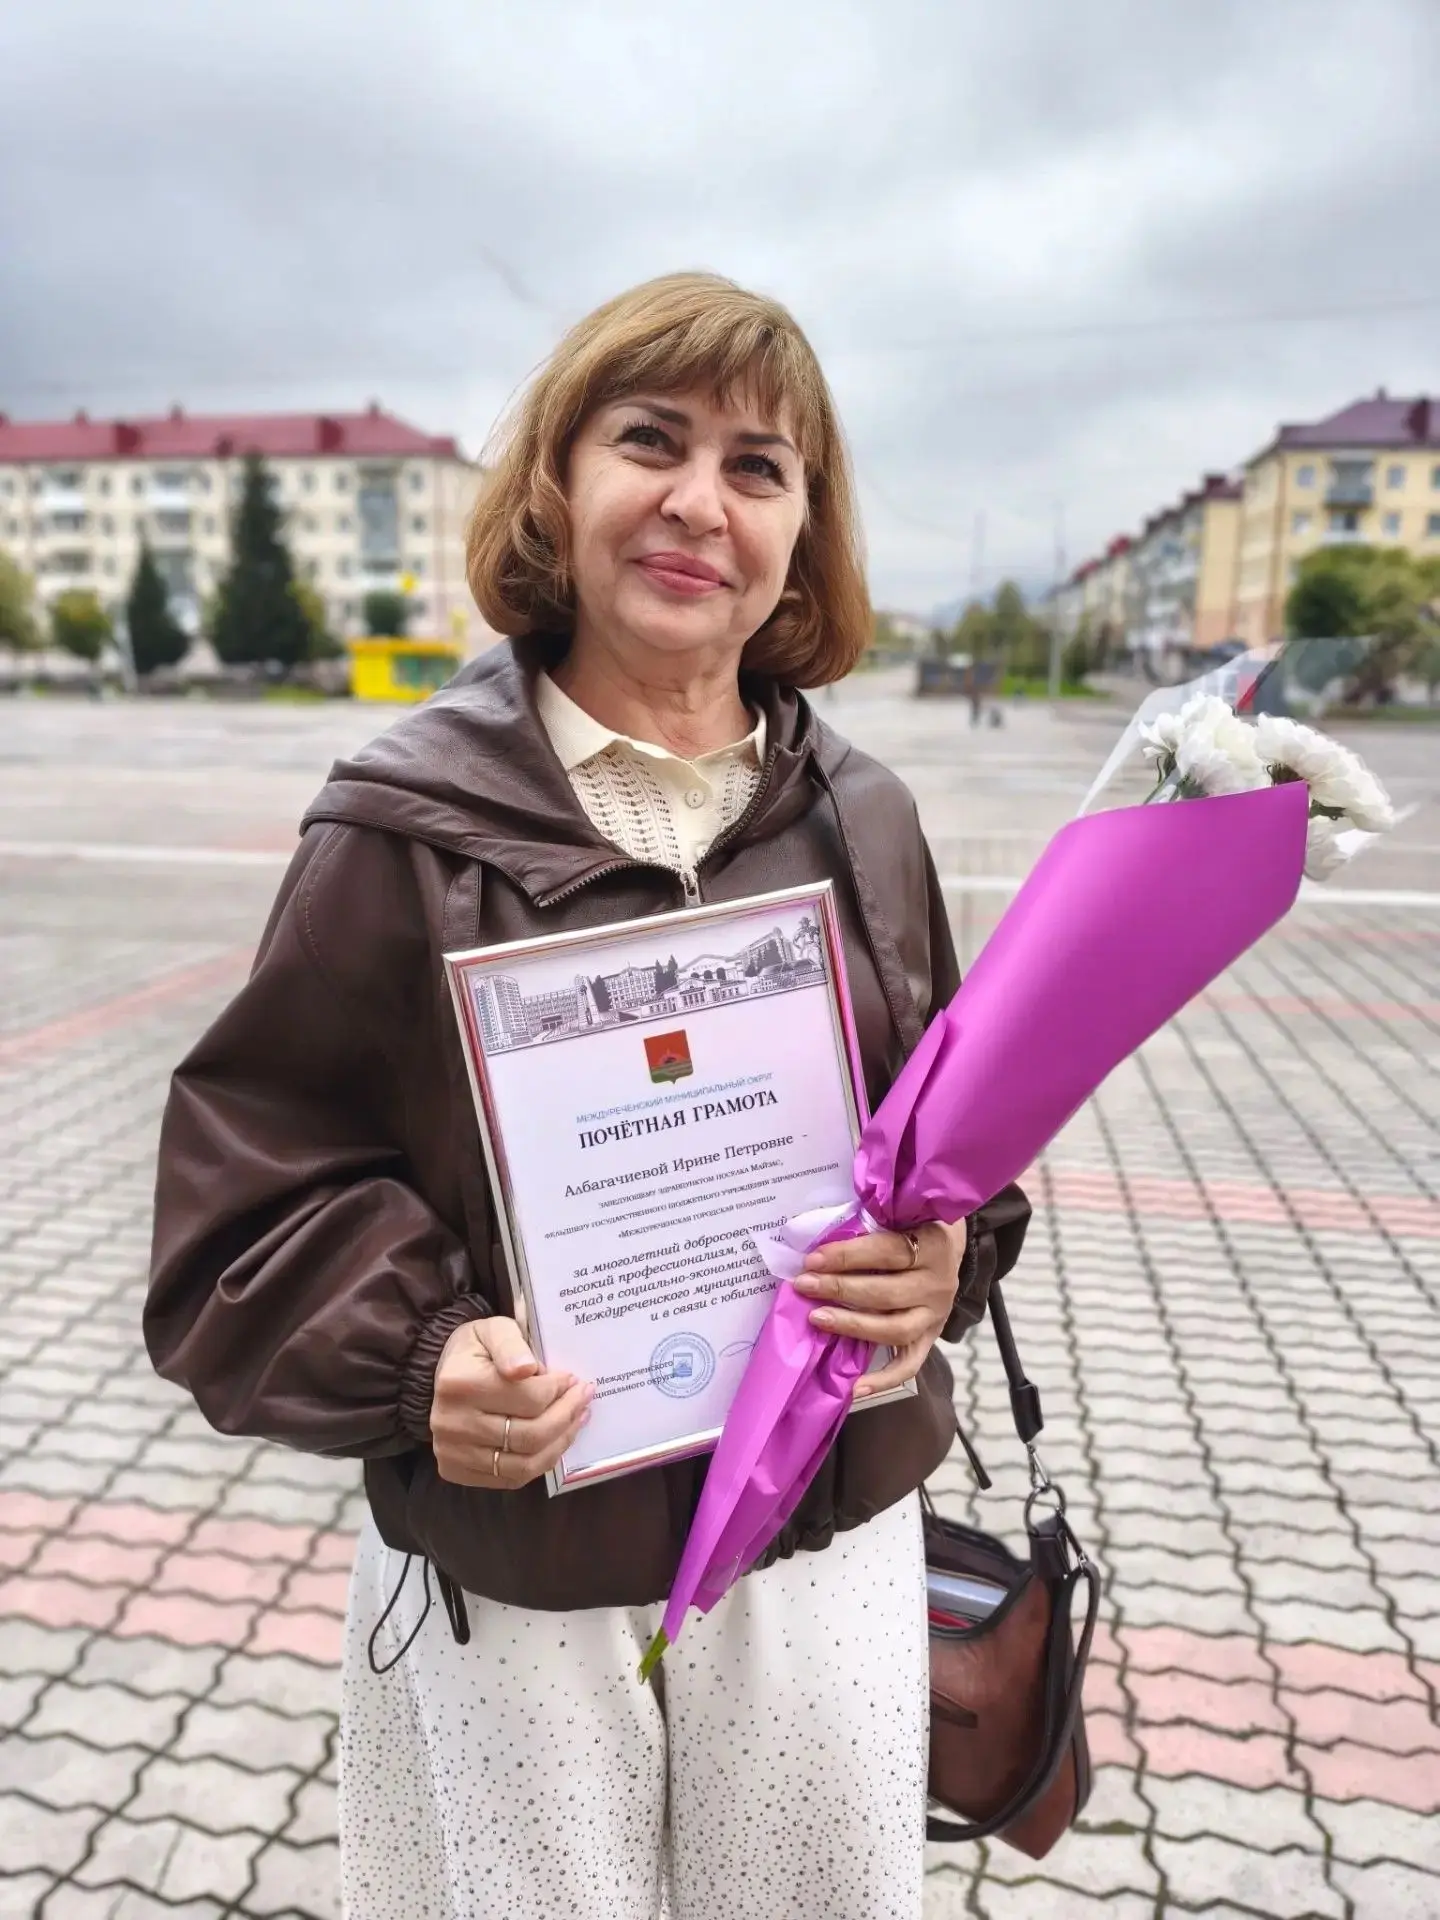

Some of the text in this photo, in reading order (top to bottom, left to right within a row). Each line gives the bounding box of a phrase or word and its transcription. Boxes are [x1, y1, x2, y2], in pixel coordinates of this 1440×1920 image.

[576, 1072, 773, 1124] МЕЖДУРЕЧЕНСКИЙ МУНИЦИПАЛЬНЫЙ ОКРУГ
[578, 1089, 779, 1149] ПОЧЁТНАЯ ГРАМОТА
[564, 1163, 669, 1198] Албагачиевой
[673, 1152, 721, 1173] Ирине
[724, 1135, 794, 1160] Петровне
[559, 1247, 738, 1298] высокий профессионализм,
[564, 1254, 763, 1313] вклад в социально-экономичес
[573, 1267, 589, 1279] за
[592, 1242, 681, 1274] многолетний
[574, 1268, 773, 1326] Междуреченского муниципаль
[651, 1281, 778, 1322] и в связи с юбилеем
[596, 1359, 674, 1387] Междуреченского
